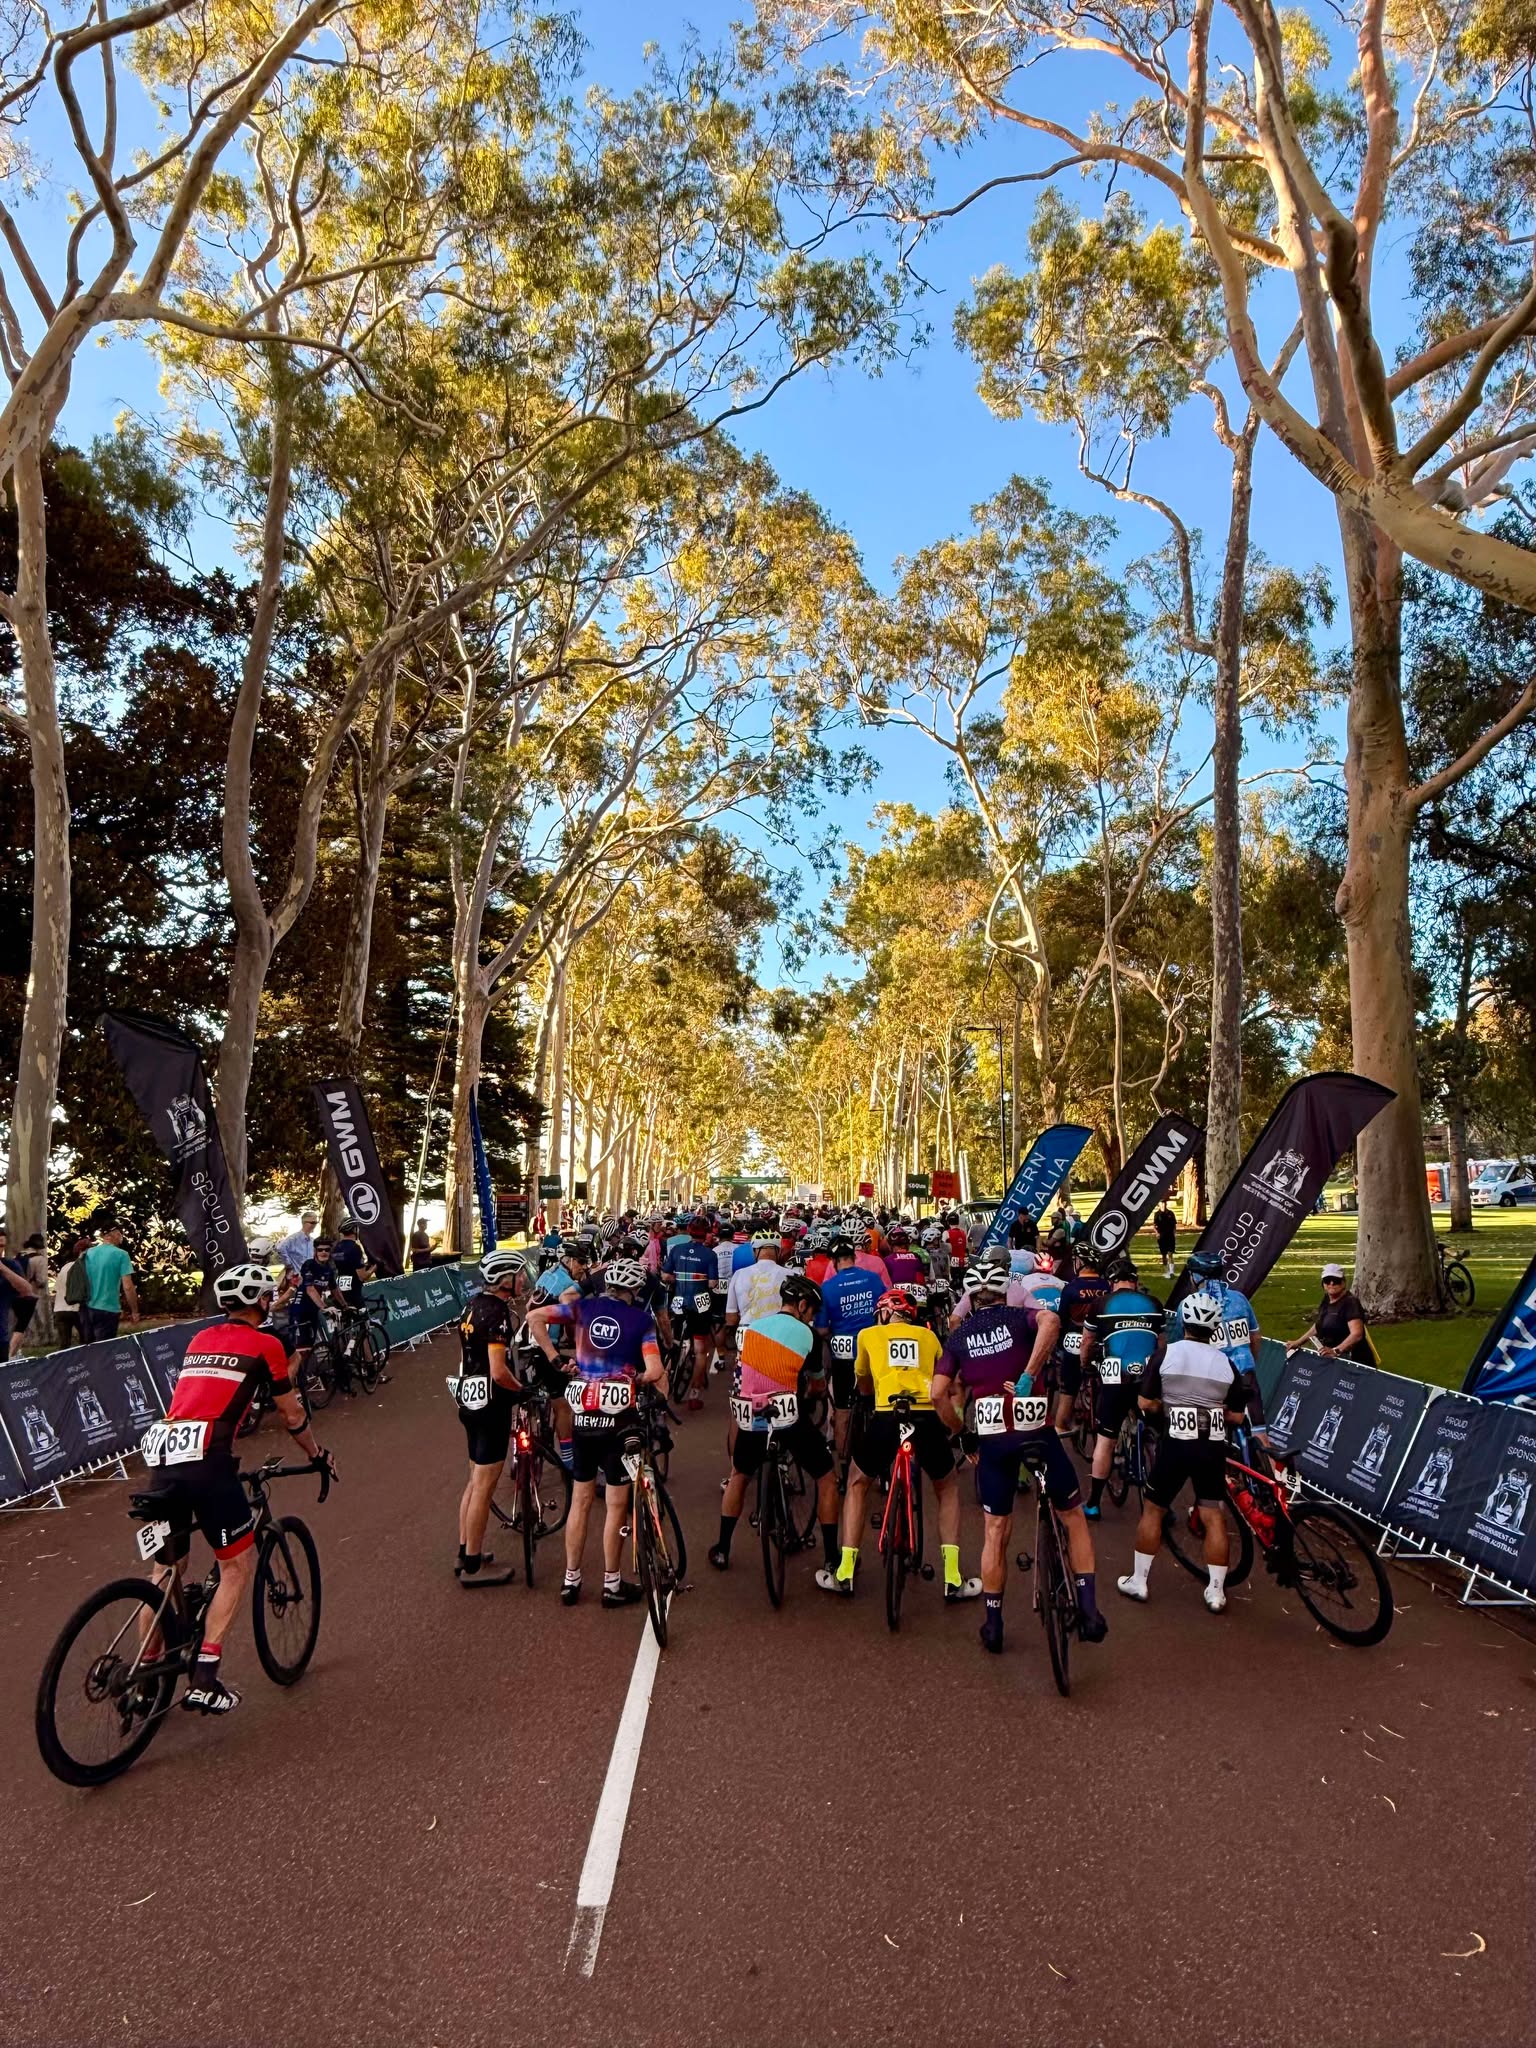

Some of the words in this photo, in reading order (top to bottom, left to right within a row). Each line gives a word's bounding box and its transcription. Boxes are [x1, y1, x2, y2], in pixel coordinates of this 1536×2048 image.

[326, 1091, 367, 1178] GWM
[1120, 1128, 1189, 1212] GWM
[1026, 1158, 1070, 1219] RALIA
[1218, 1211, 1254, 1266] ROUD
[1223, 1221, 1269, 1288] ONSOR
[840, 1290, 873, 1305] RIDING
[841, 1303, 852, 1312] TO
[853, 1299, 873, 1309] BEAT
[592, 1322, 618, 1338] CRT
[966, 1324, 1012, 1350] MALAGA
[1227, 1321, 1249, 1340] 660
[832, 1338, 852, 1354] 668
[889, 1342, 916, 1360] 601
[968, 1344, 995, 1359] CYCLING
[994, 1337, 1014, 1354] GROUP
[1064, 1335, 1081, 1349] 655
[1101, 1360, 1120, 1378] 620
[463, 1380, 486, 1403] 628
[566, 1383, 582, 1405] 708
[601, 1385, 630, 1406] 708
[731, 1401, 751, 1423] 614
[977, 1401, 1003, 1425] 632
[1014, 1401, 1047, 1423] 632
[1170, 1410, 1197, 1431] 468
[1210, 1411, 1224, 1432] 46
[1445, 1415, 1468, 1429] PROUD
[167, 1424, 202, 1453] 631
[1436, 1426, 1467, 1441] SPONSOR
[140, 1526, 158, 1554] 631
[1508, 1536, 1518, 1544] OF
